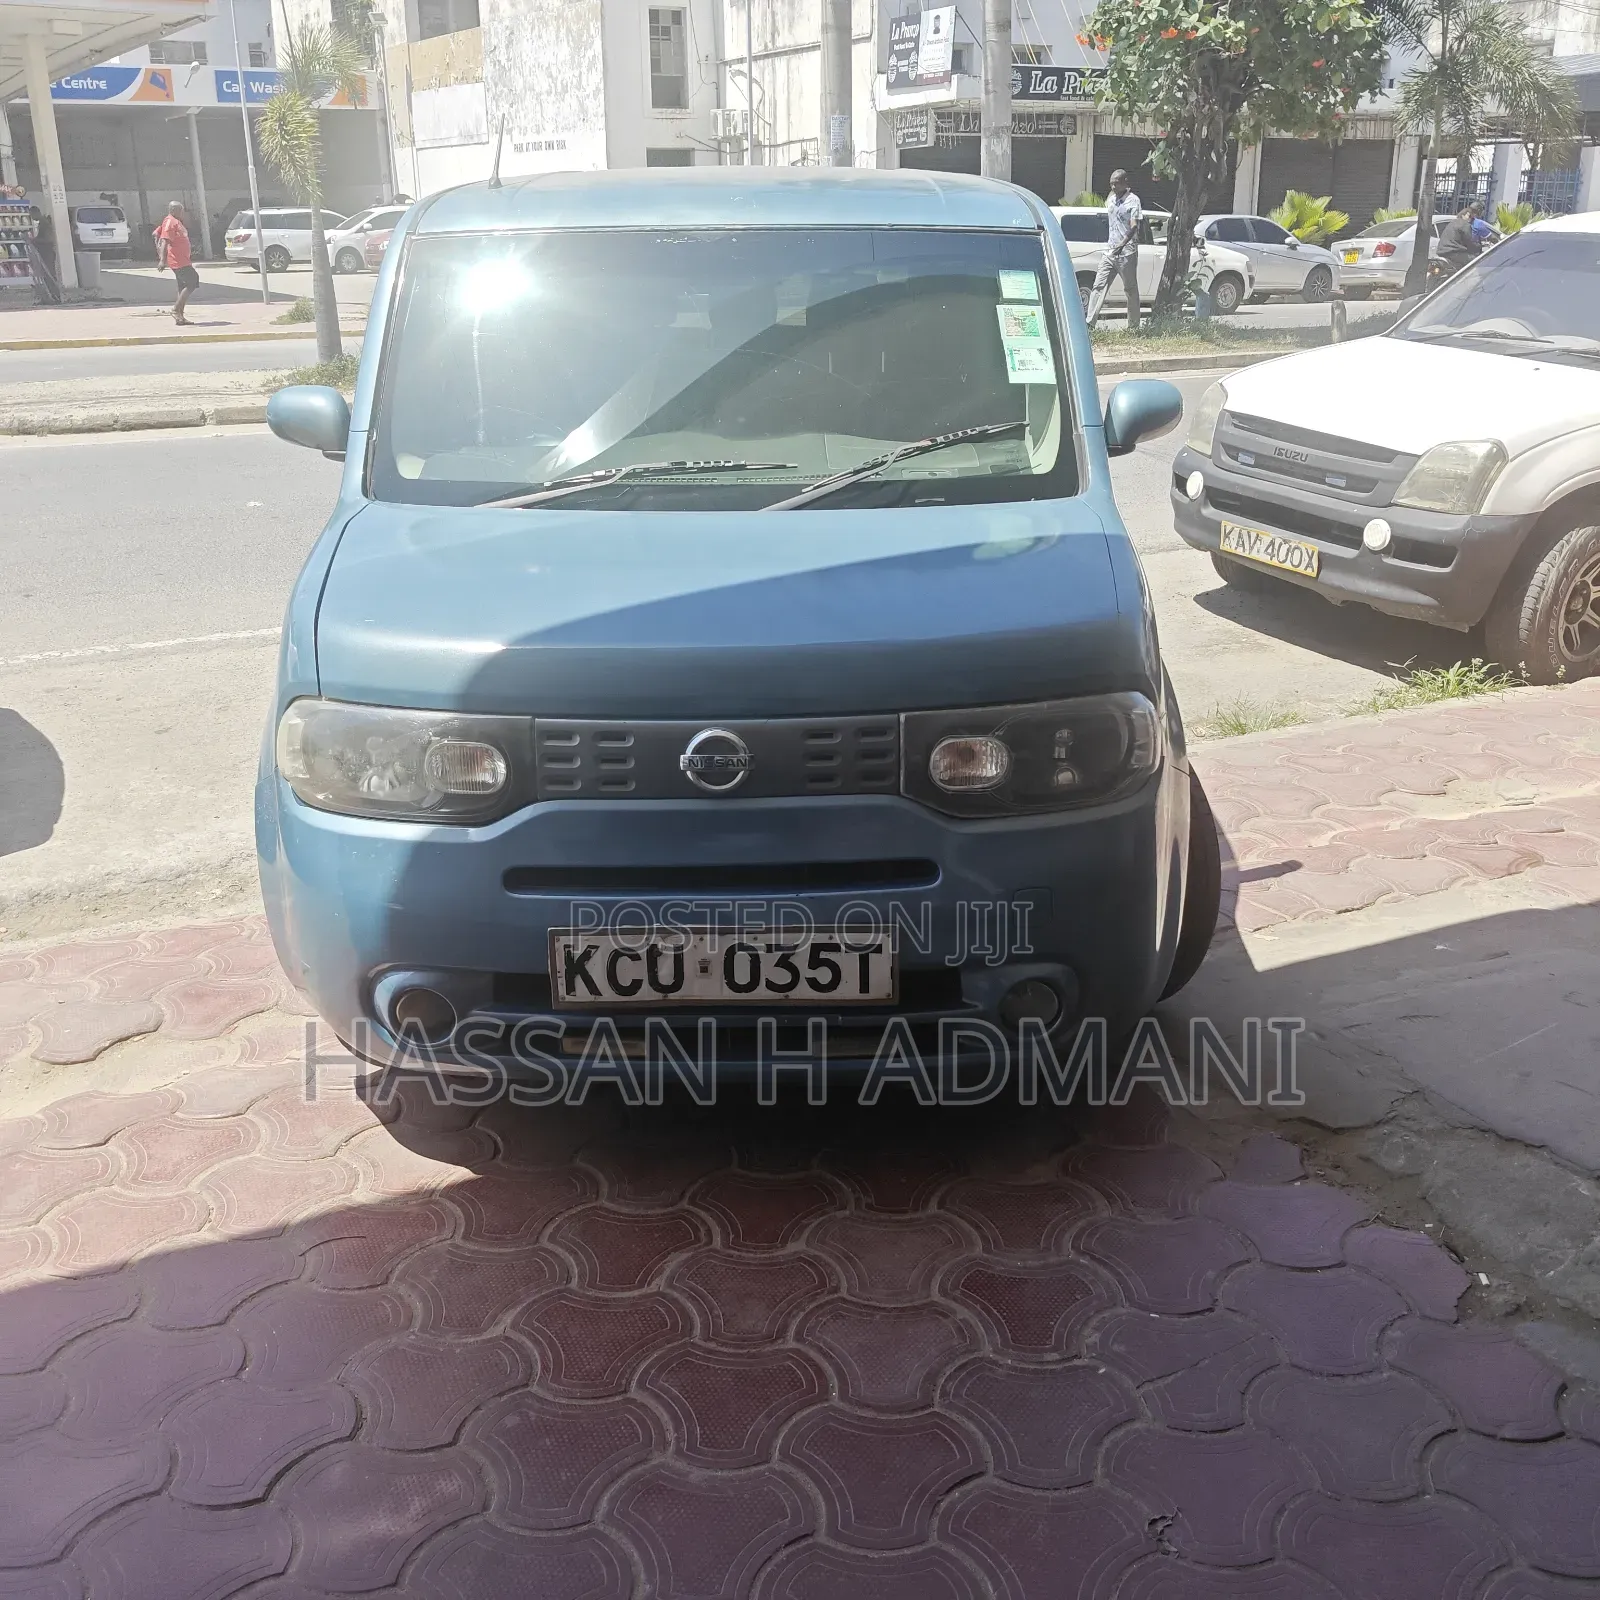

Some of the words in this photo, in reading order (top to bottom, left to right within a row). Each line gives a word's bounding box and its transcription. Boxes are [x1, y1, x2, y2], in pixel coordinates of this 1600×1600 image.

[61, 76, 107, 90] Centre
[222, 80, 246, 93] Ca
[1029, 70, 1058, 94] La
[513, 143, 524, 153] PARK
[531, 141, 543, 152] YOUR
[544, 140, 555, 151] OWN
[556, 139, 567, 151] RISK
[1273, 446, 1309, 463] ISUZU
[1222, 524, 1261, 556] KAV
[1263, 536, 1316, 573] 400X
[687, 757, 748, 769] NISSAN
[563, 943, 685, 998] KCU
[722, 941, 884, 995] 035T
